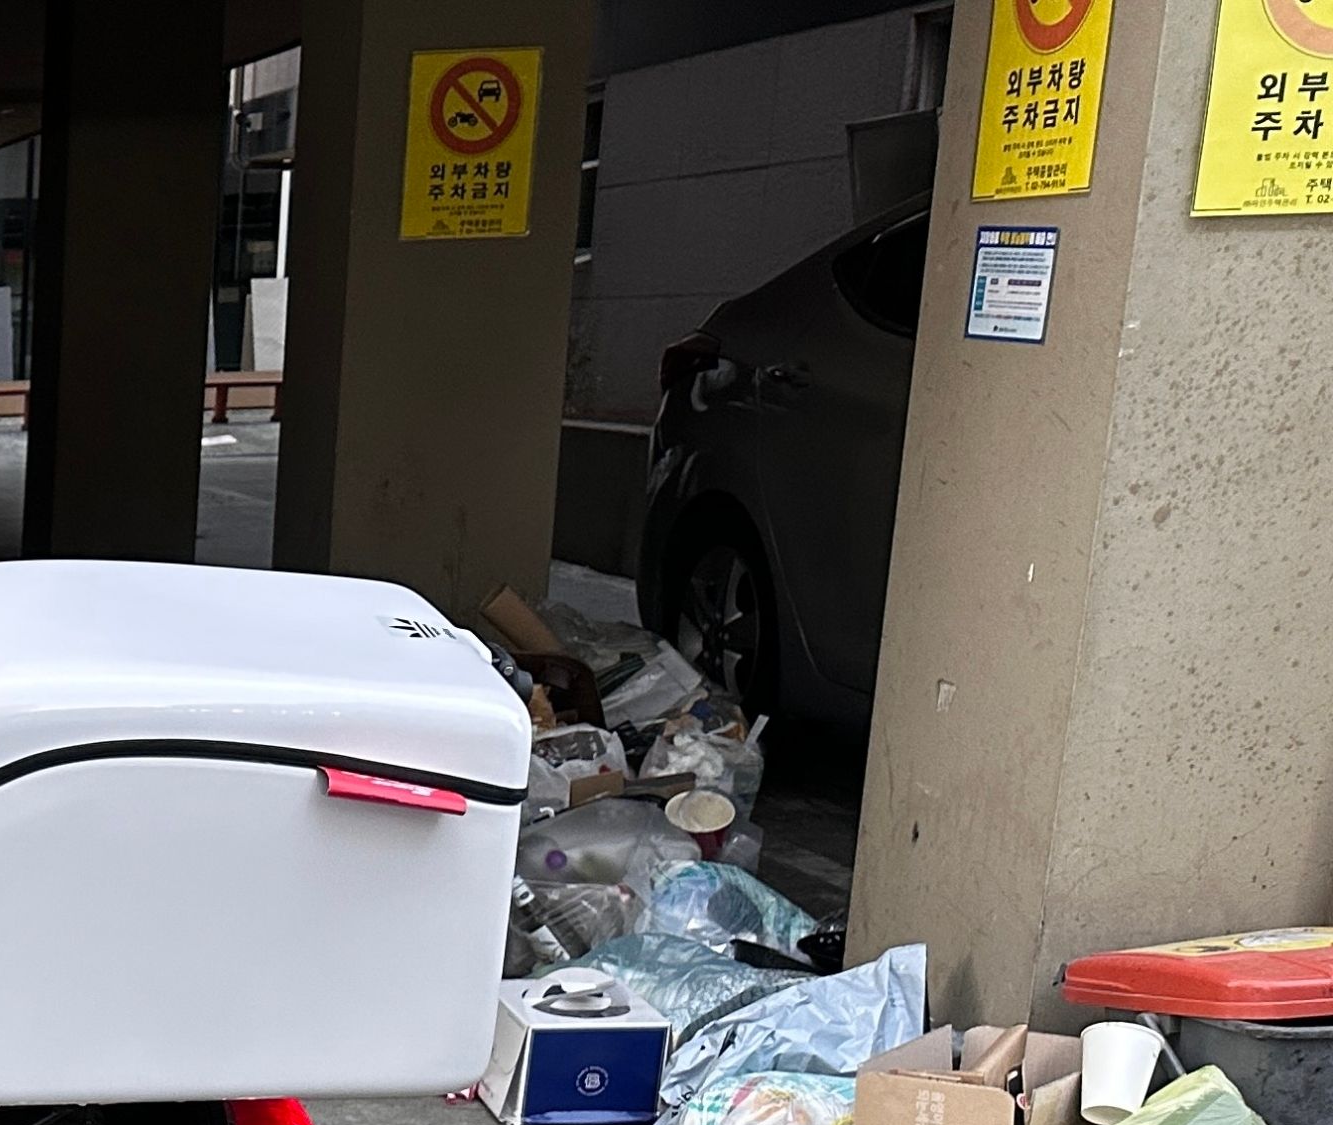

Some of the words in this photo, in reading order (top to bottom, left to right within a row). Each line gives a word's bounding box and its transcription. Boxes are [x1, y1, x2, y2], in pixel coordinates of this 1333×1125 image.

[1006, 58, 1086, 98] 외부차량
[1002, 95, 1081, 133] 주차금지
[430, 161, 511, 181] 외부차량
[428, 182, 509, 201] 주차금지
